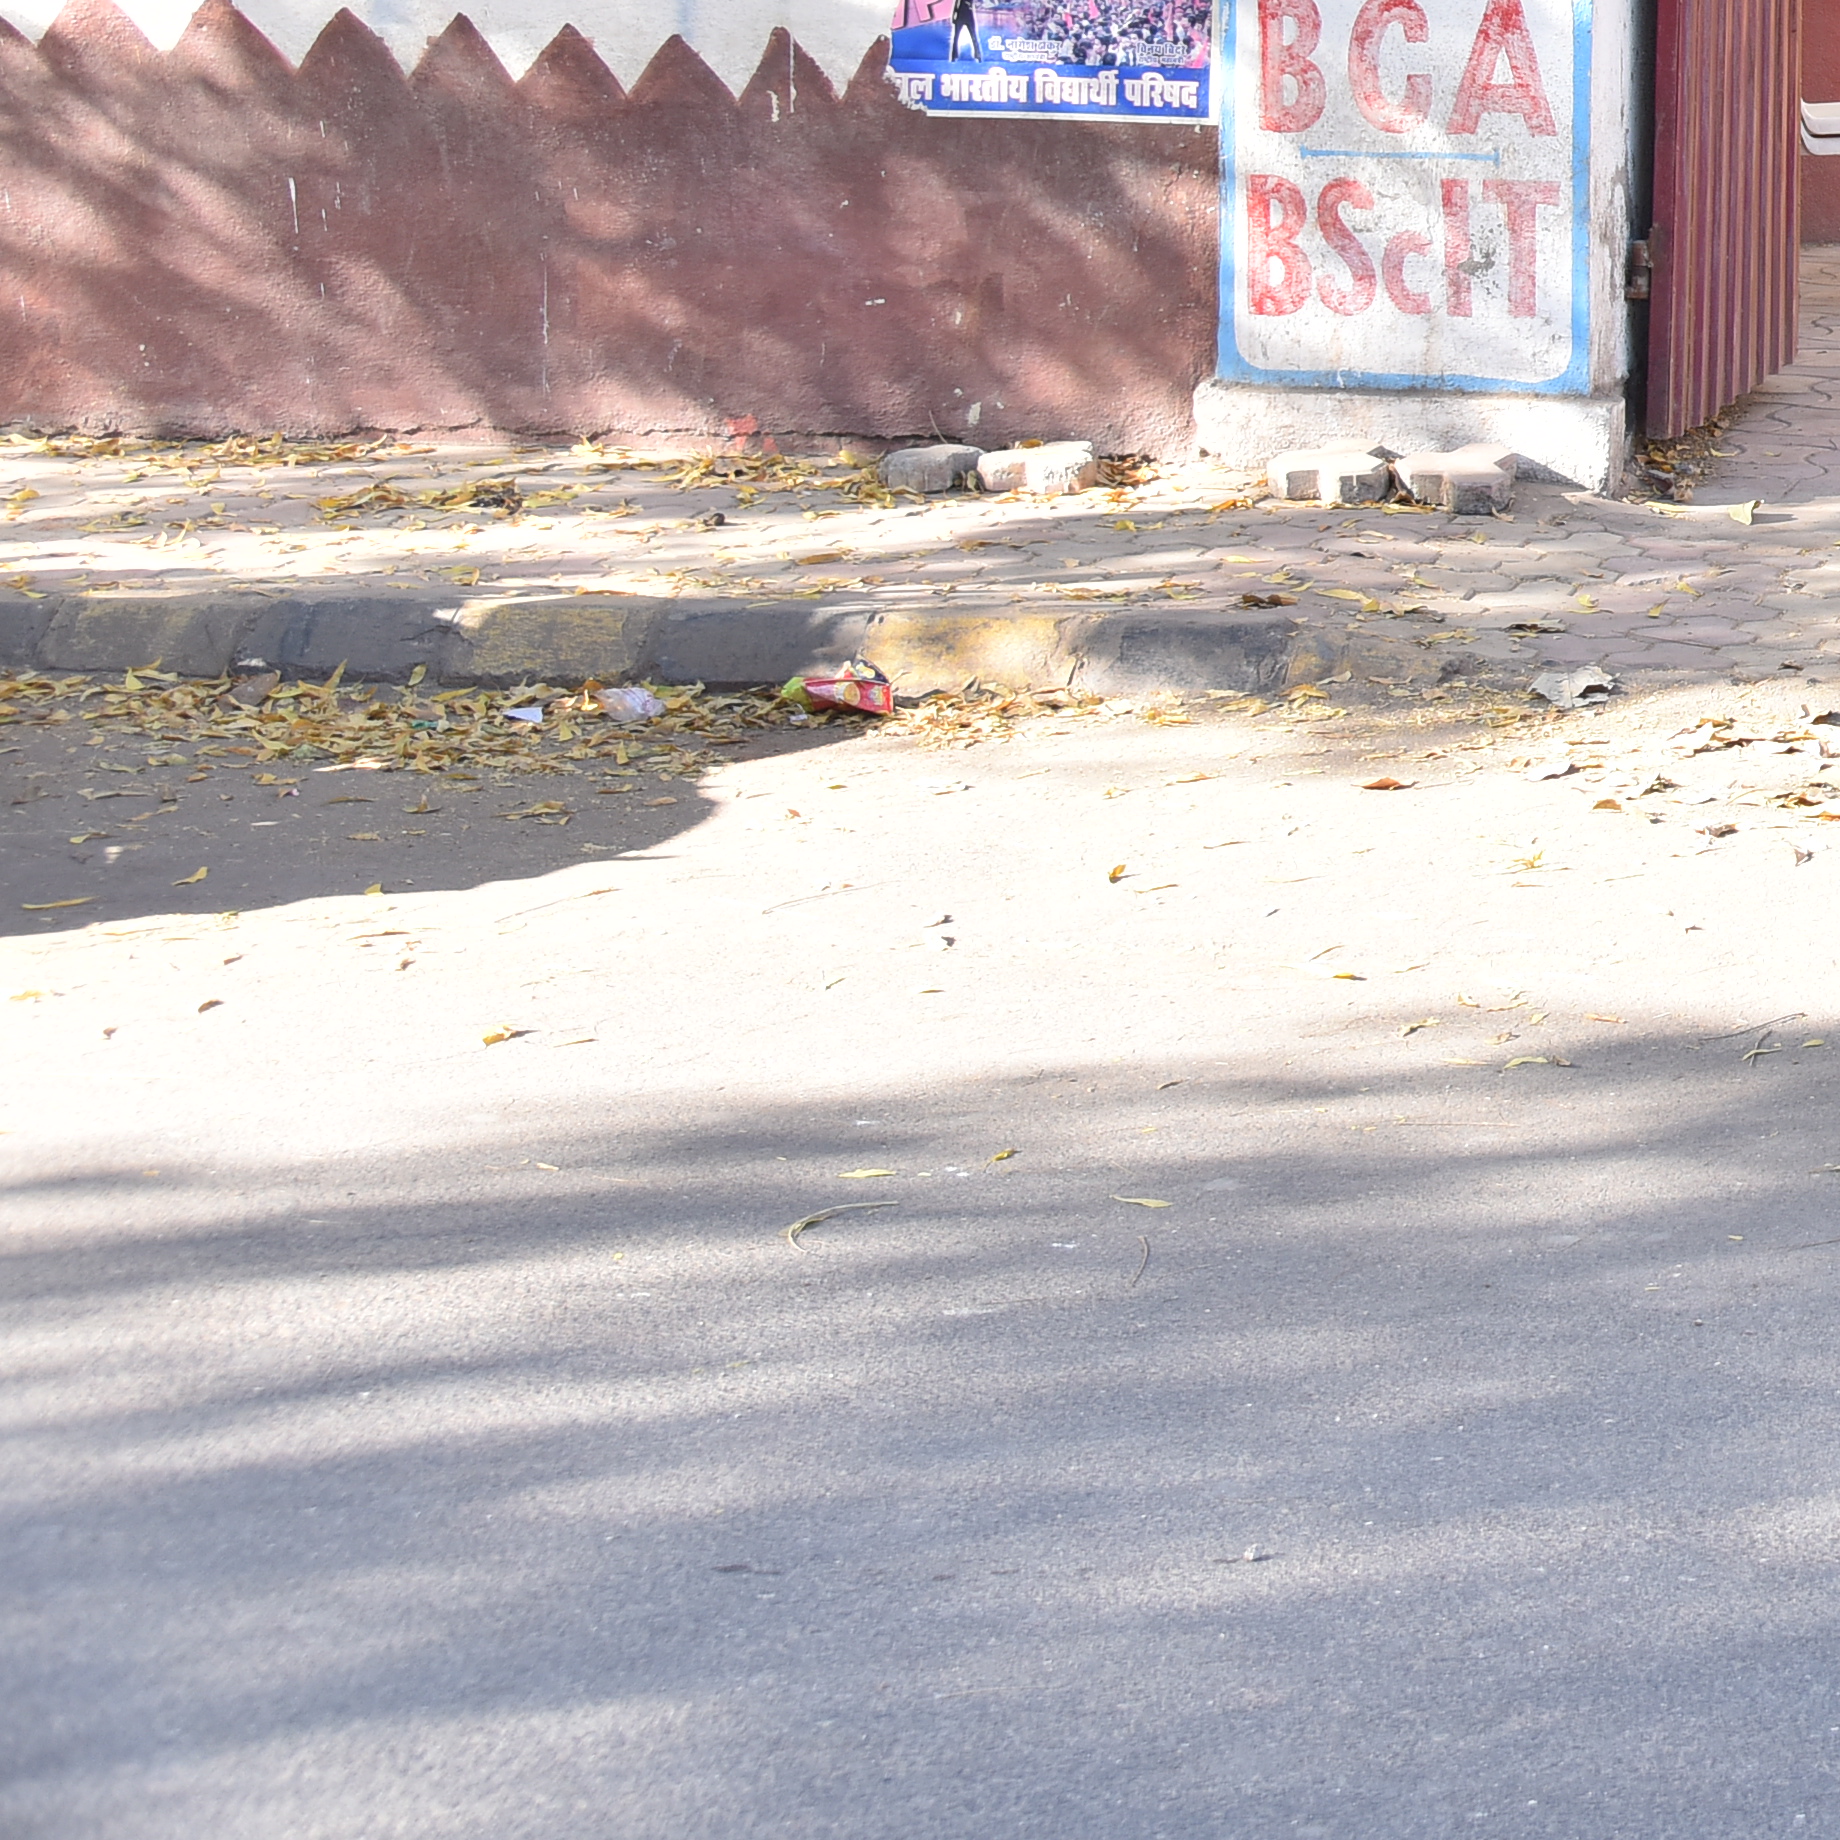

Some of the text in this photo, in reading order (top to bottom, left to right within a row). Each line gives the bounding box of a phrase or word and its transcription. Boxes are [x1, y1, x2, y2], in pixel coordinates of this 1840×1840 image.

[941, 66, 1028, 103] भारतीय
[1035, 67, 1119, 106] विद्यार्थी
[1124, 71, 1199, 108] परिषद
